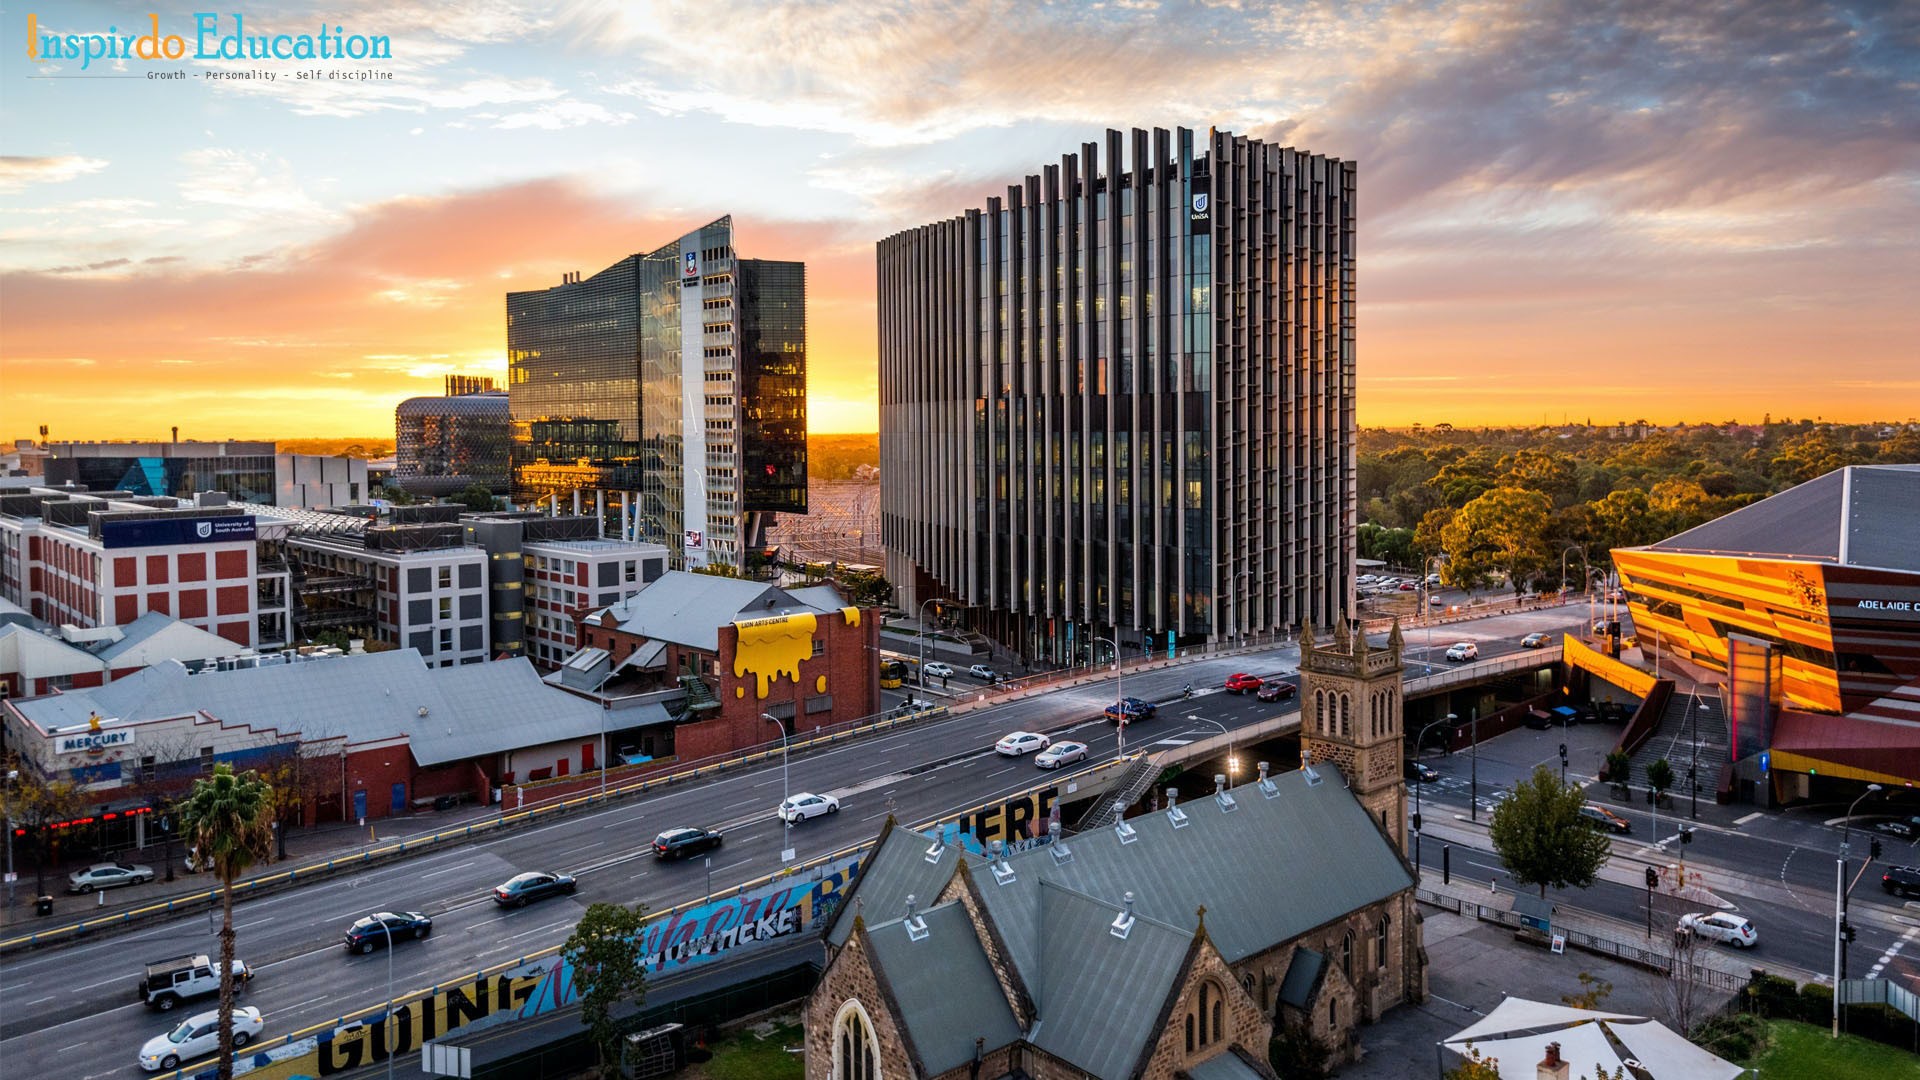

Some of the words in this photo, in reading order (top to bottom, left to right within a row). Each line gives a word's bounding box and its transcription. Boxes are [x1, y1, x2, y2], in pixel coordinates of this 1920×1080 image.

[1857, 600, 1911, 611] ADELAIDE
[754, 619, 768, 627] ARTS
[64, 732, 127, 750] MERCURY
[318, 974, 538, 1076] GOING
